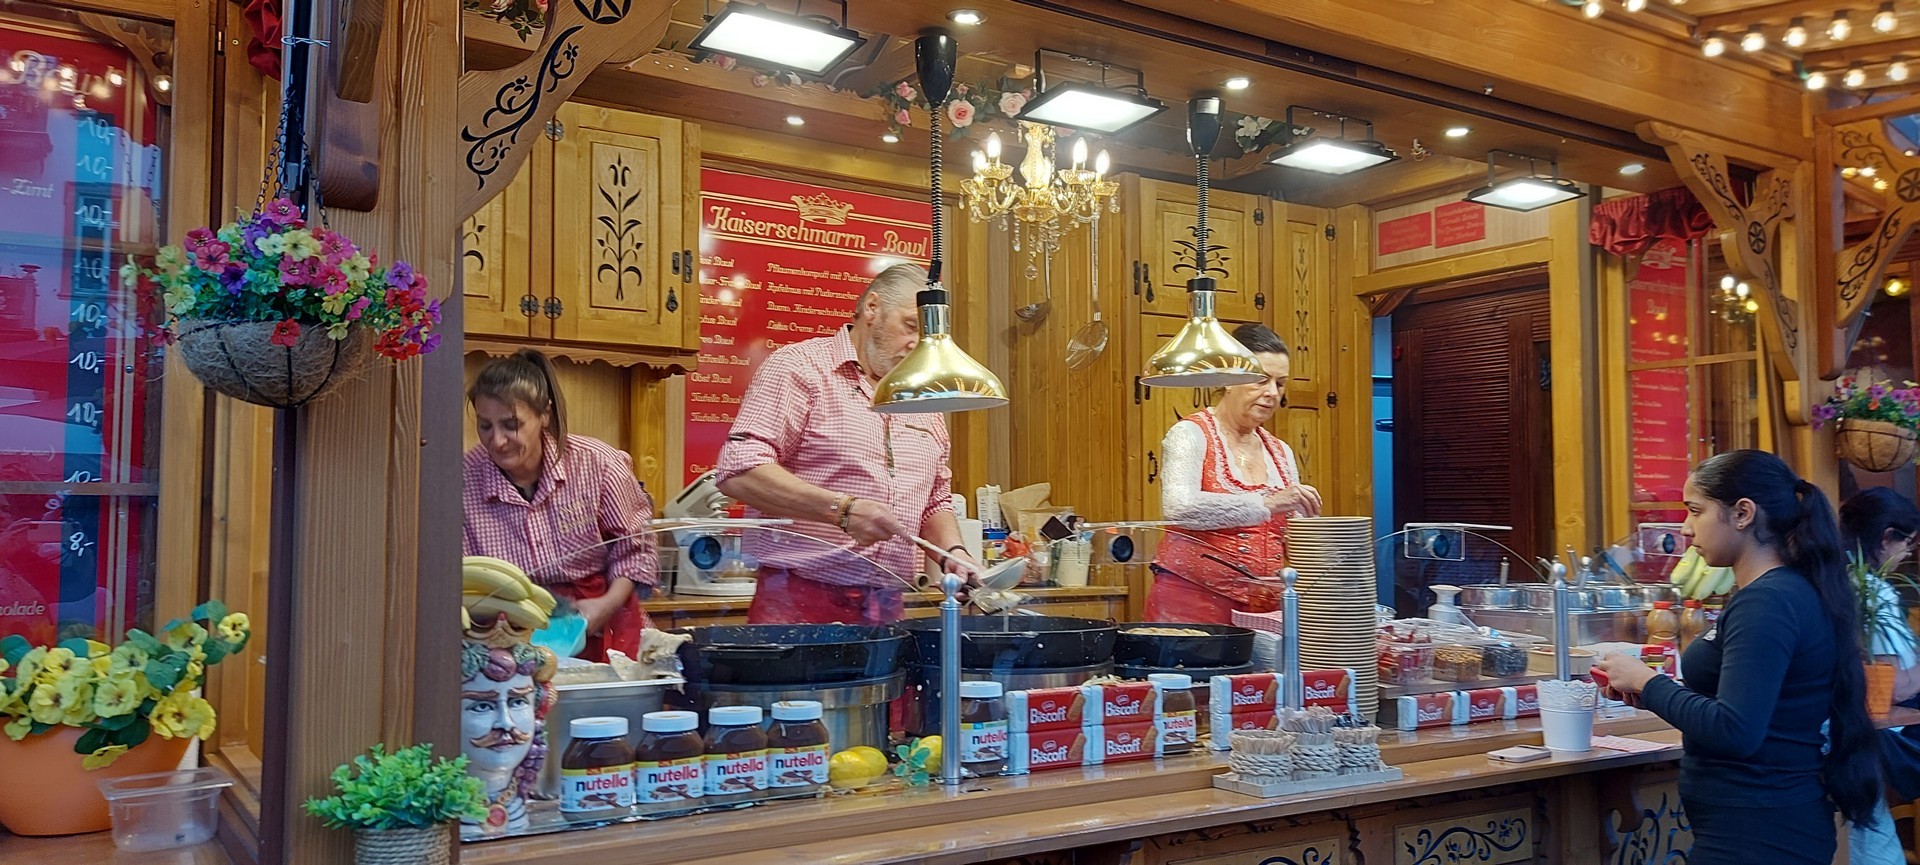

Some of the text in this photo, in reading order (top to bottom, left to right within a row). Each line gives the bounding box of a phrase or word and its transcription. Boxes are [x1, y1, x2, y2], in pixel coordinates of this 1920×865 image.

[707, 205, 865, 249] Kaiserschmarrn
[881, 229, 929, 257] Bowl
[71, 303, 108, 329] 10,-
[69, 351, 105, 374] 10,-
[67, 402, 104, 427] 10,-
[69, 531, 94, 557] 8,-
[1232, 690, 1264, 706] Biscoff
[1304, 685, 1336, 700] Biscoff
[1030, 706, 1067, 724] Biscoff
[1105, 700, 1141, 717] Biscoff
[1031, 746, 1068, 764] Biscoff
[1106, 738, 1141, 755] Biscoff
[717, 758, 764, 776] nutella
[775, 752, 823, 769] nutella
[576, 773, 628, 792] nutella
[648, 765, 699, 784] nutella
